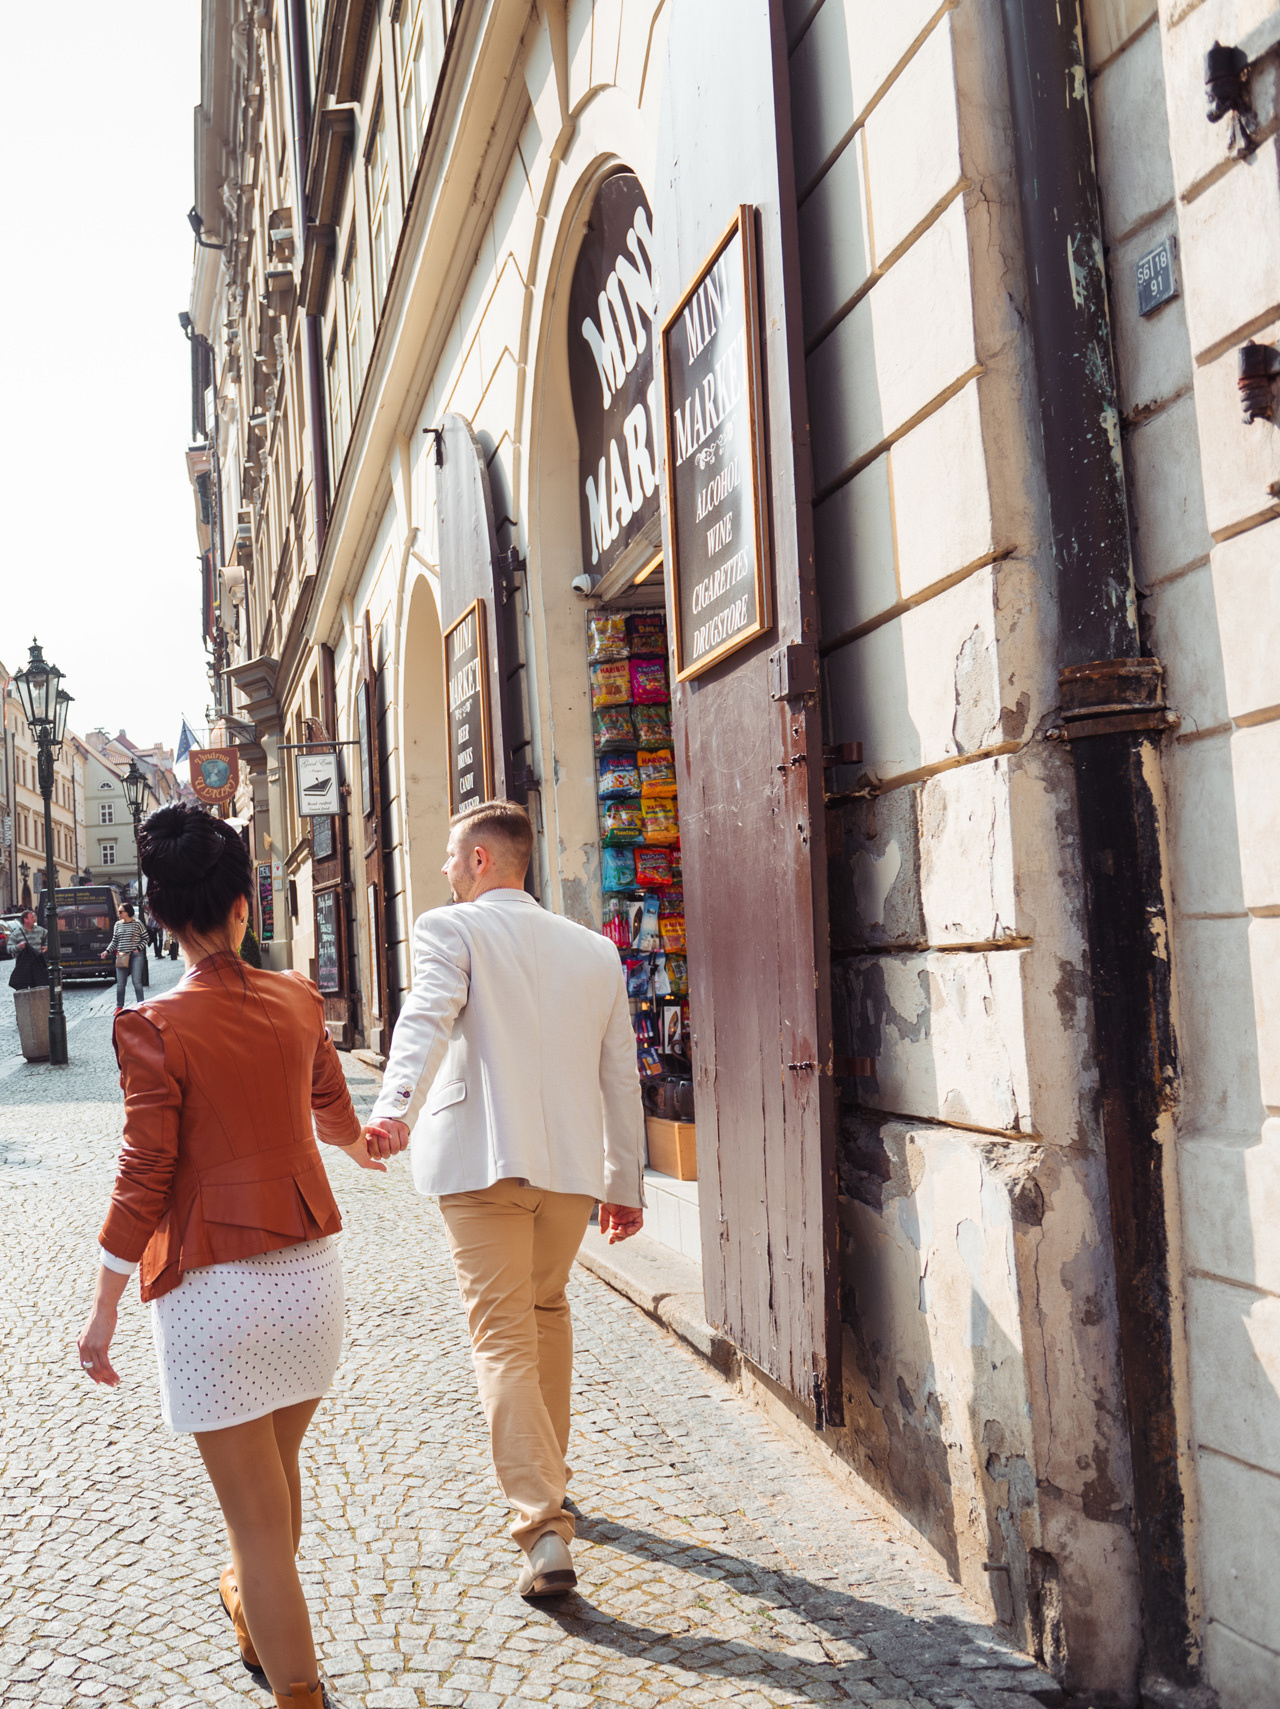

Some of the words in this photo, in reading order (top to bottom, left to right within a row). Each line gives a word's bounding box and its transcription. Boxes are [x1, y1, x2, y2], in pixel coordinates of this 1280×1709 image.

[683, 253, 731, 366] MINI
[674, 327, 747, 467] MARKET
[696, 456, 741, 523] ALCOHOL
[706, 511, 733, 558] WINE
[692, 545, 749, 615] CIGARETTES
[453, 614, 472, 662] MINI
[692, 594, 748, 659] DRUGSTORE
[449, 656, 480, 713] MARKET
[600, 665, 626, 674] HARIBO
[458, 723, 470, 745] BEER
[457, 746, 474, 771] DRINKS
[641, 756, 670, 765] HARIBO
[460, 772, 474, 794] CANDY
